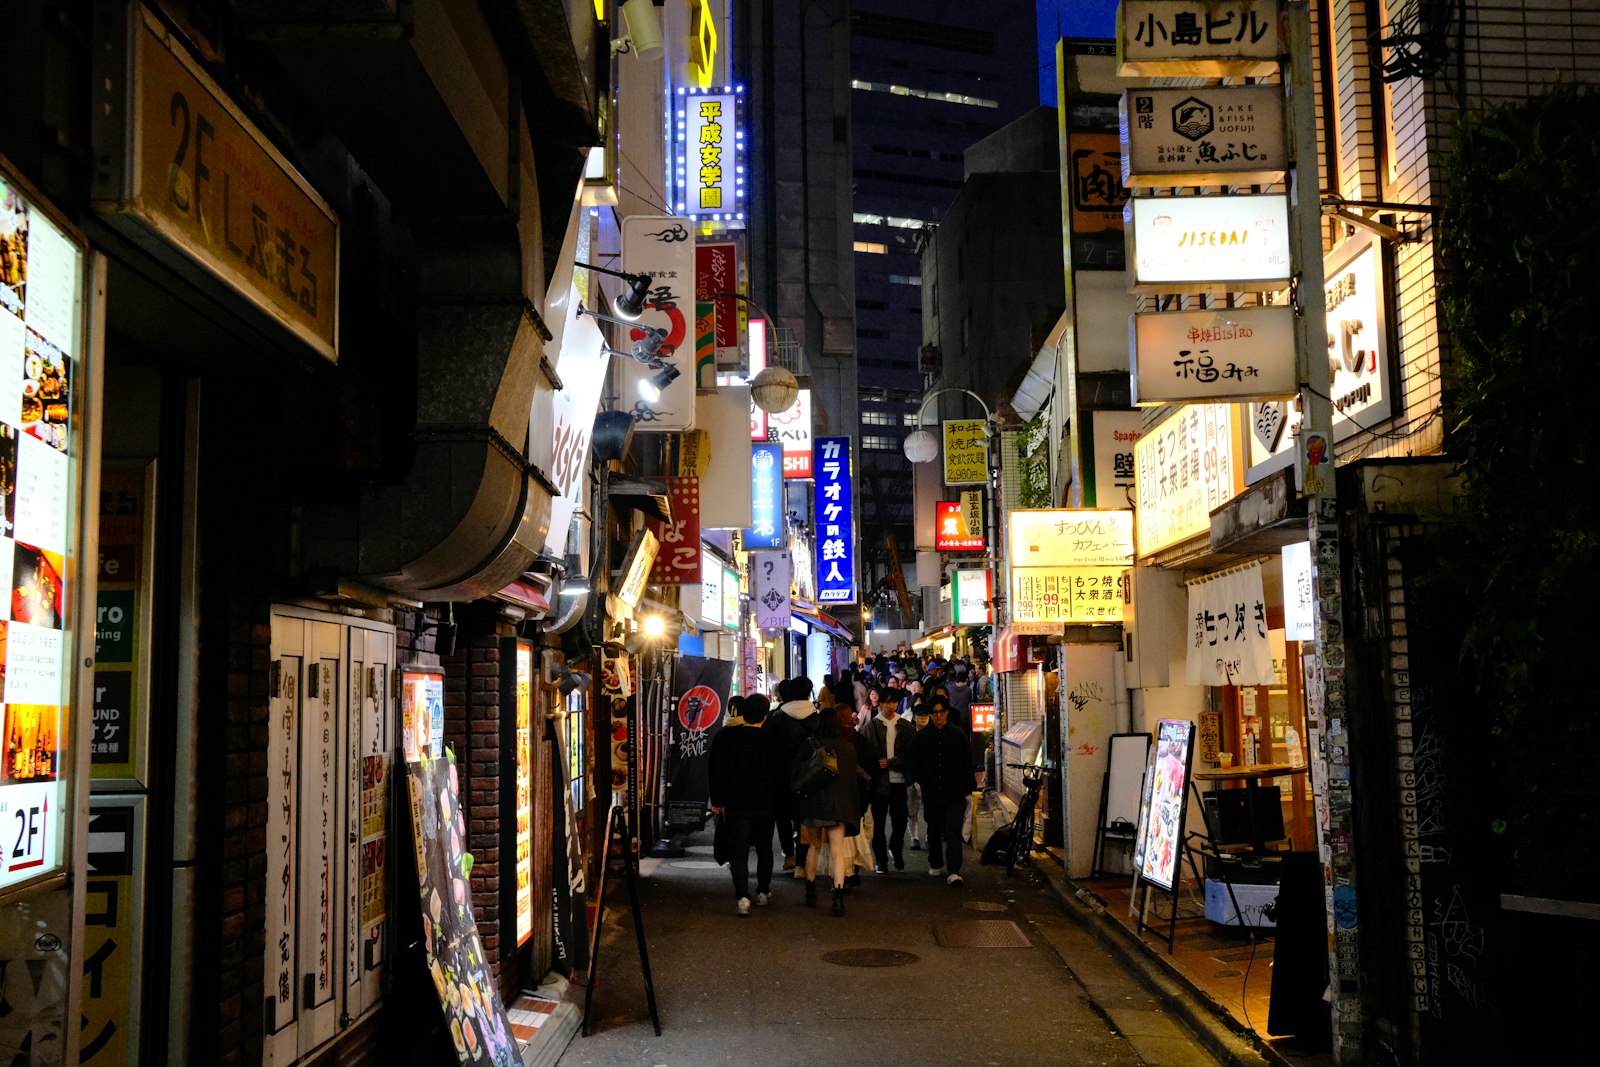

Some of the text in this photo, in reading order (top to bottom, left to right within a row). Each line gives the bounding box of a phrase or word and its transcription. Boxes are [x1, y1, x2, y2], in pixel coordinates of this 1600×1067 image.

[1135, 11, 1268, 47] 小島ビル
[1136, 97, 1153, 129] 2階
[1218, 104, 1253, 112] SAKE
[1220, 125, 1254, 133] UOFUJI
[700, 101, 721, 208] 平成女学園
[1195, 141, 1258, 164] 魚ふじ
[1177, 230, 1248, 247] JISEDAI
[767, 427, 808, 442] 魚べい
[948, 423, 981, 435] 和牛
[1159, 448, 1200, 500] 大衆酒場
[1204, 446, 1217, 485] 99
[753, 472, 775, 537] セキネ
[822, 440, 847, 582] カラオケの鉄人
[968, 493, 981, 536] 道玄坂小路
[1055, 519, 1106, 536] すっぴん
[771, 538, 780, 546] 1F
[1022, 577, 1030, 600] ハイボール
[1035, 577, 1043, 617] レモンサワー
[1043, 594, 1059, 606] 99
[1060, 576, 1070, 616] もつ焼き
[1017, 601, 1034, 612] 299
[680, 739, 708, 759] DEVIL
[12, 807, 40, 858] 2F
